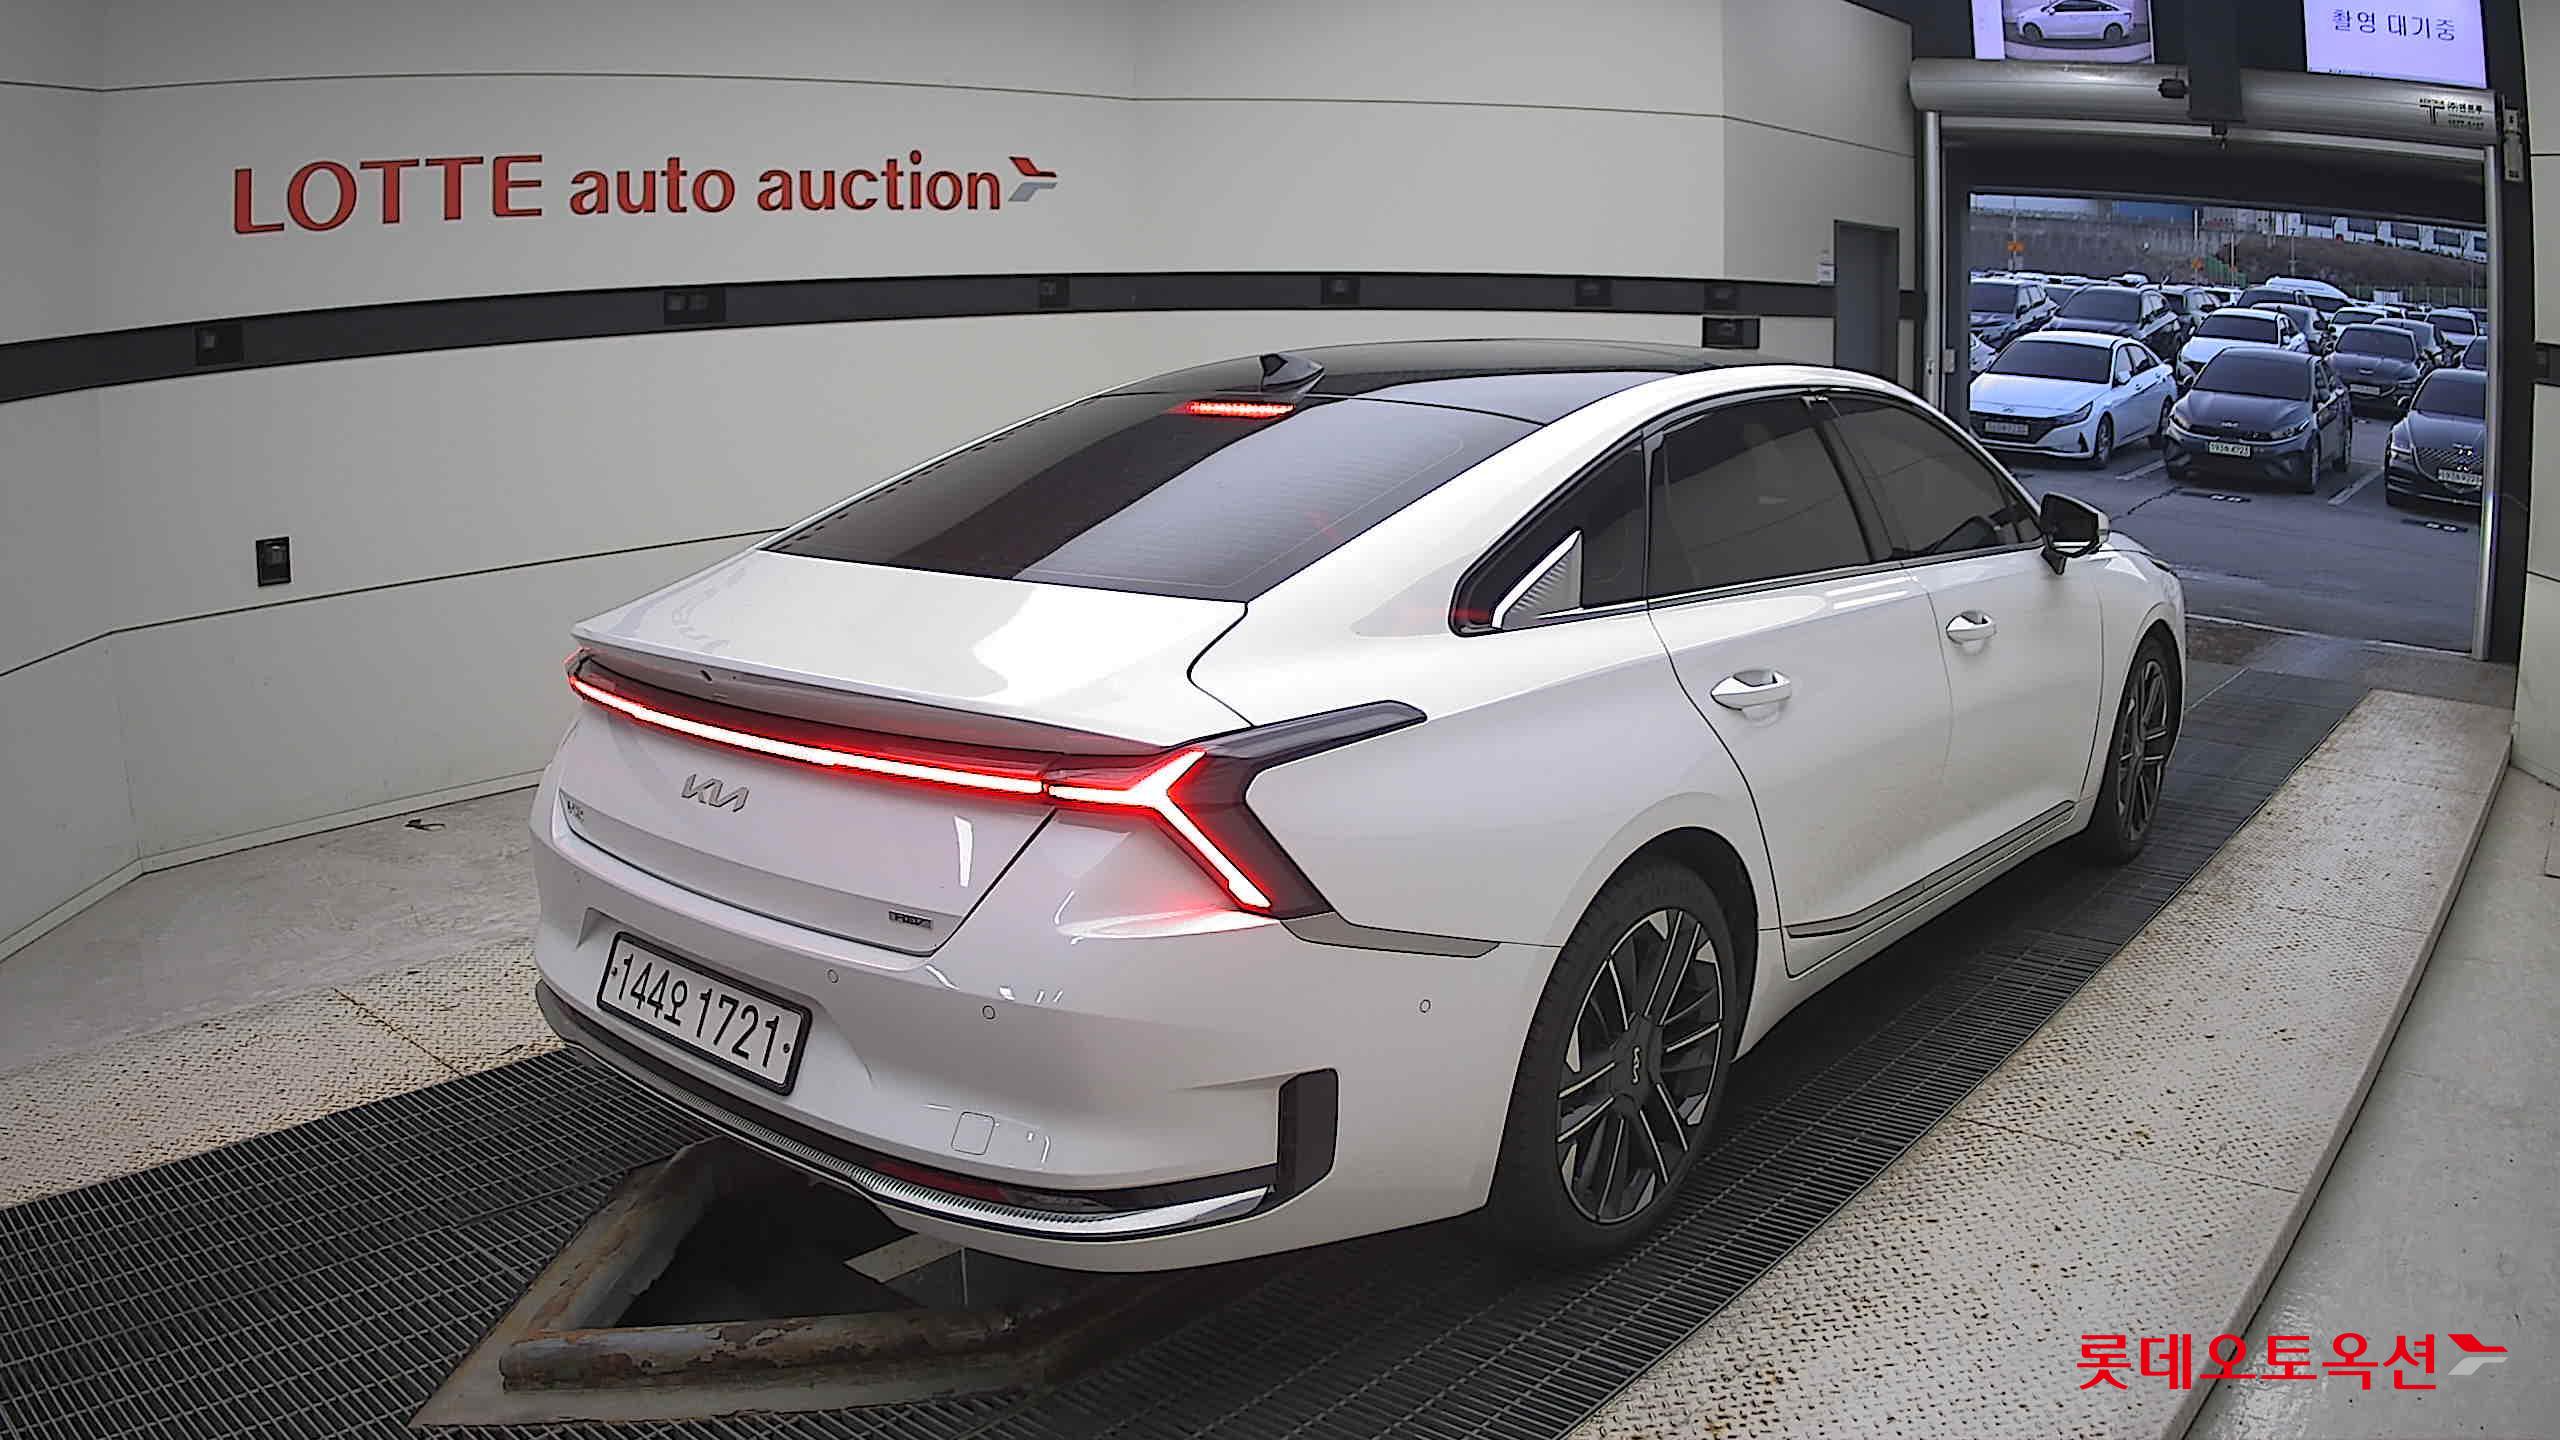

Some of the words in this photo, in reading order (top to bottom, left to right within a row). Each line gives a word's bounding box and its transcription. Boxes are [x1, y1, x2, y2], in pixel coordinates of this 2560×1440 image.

[2331, 9, 2376, 34] 촬영
[2387, 14, 2455, 41] 대기중
[235, 154, 542, 235] LOTTE
[571, 157, 736, 214] auto
[757, 150, 1001, 212] auction
[618, 953, 688, 1027] 144오
[696, 988, 779, 1068] 1721
